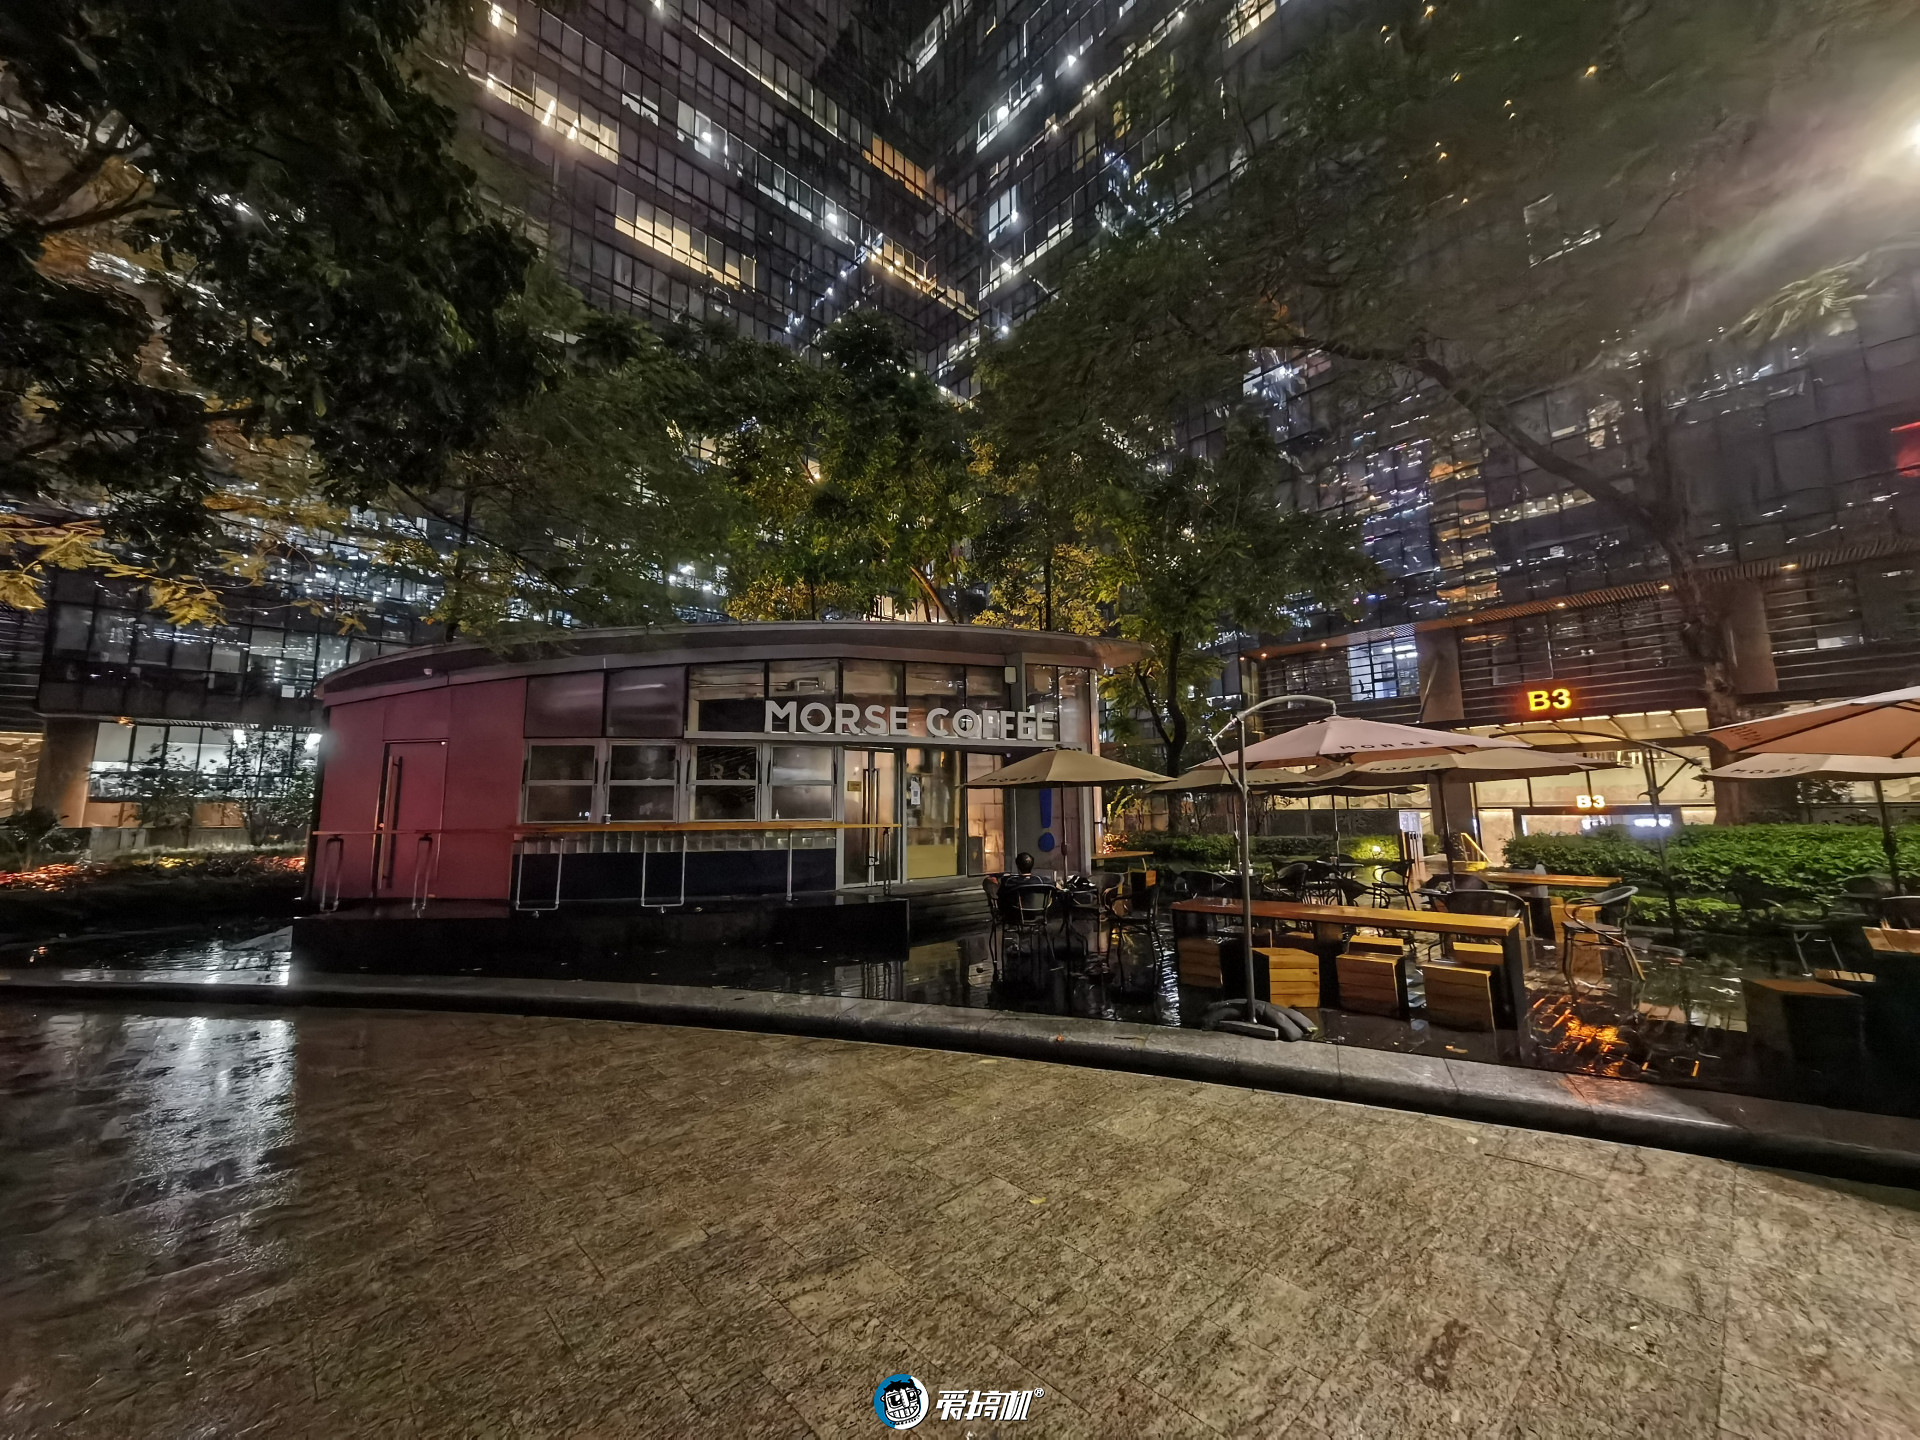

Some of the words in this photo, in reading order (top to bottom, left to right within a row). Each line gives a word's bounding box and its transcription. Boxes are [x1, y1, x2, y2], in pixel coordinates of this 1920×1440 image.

[1527, 688, 1572, 711] B3
[764, 700, 910, 735] MORSE
[926, 707, 1054, 740] COFFEE
[1576, 794, 1605, 809] B3
